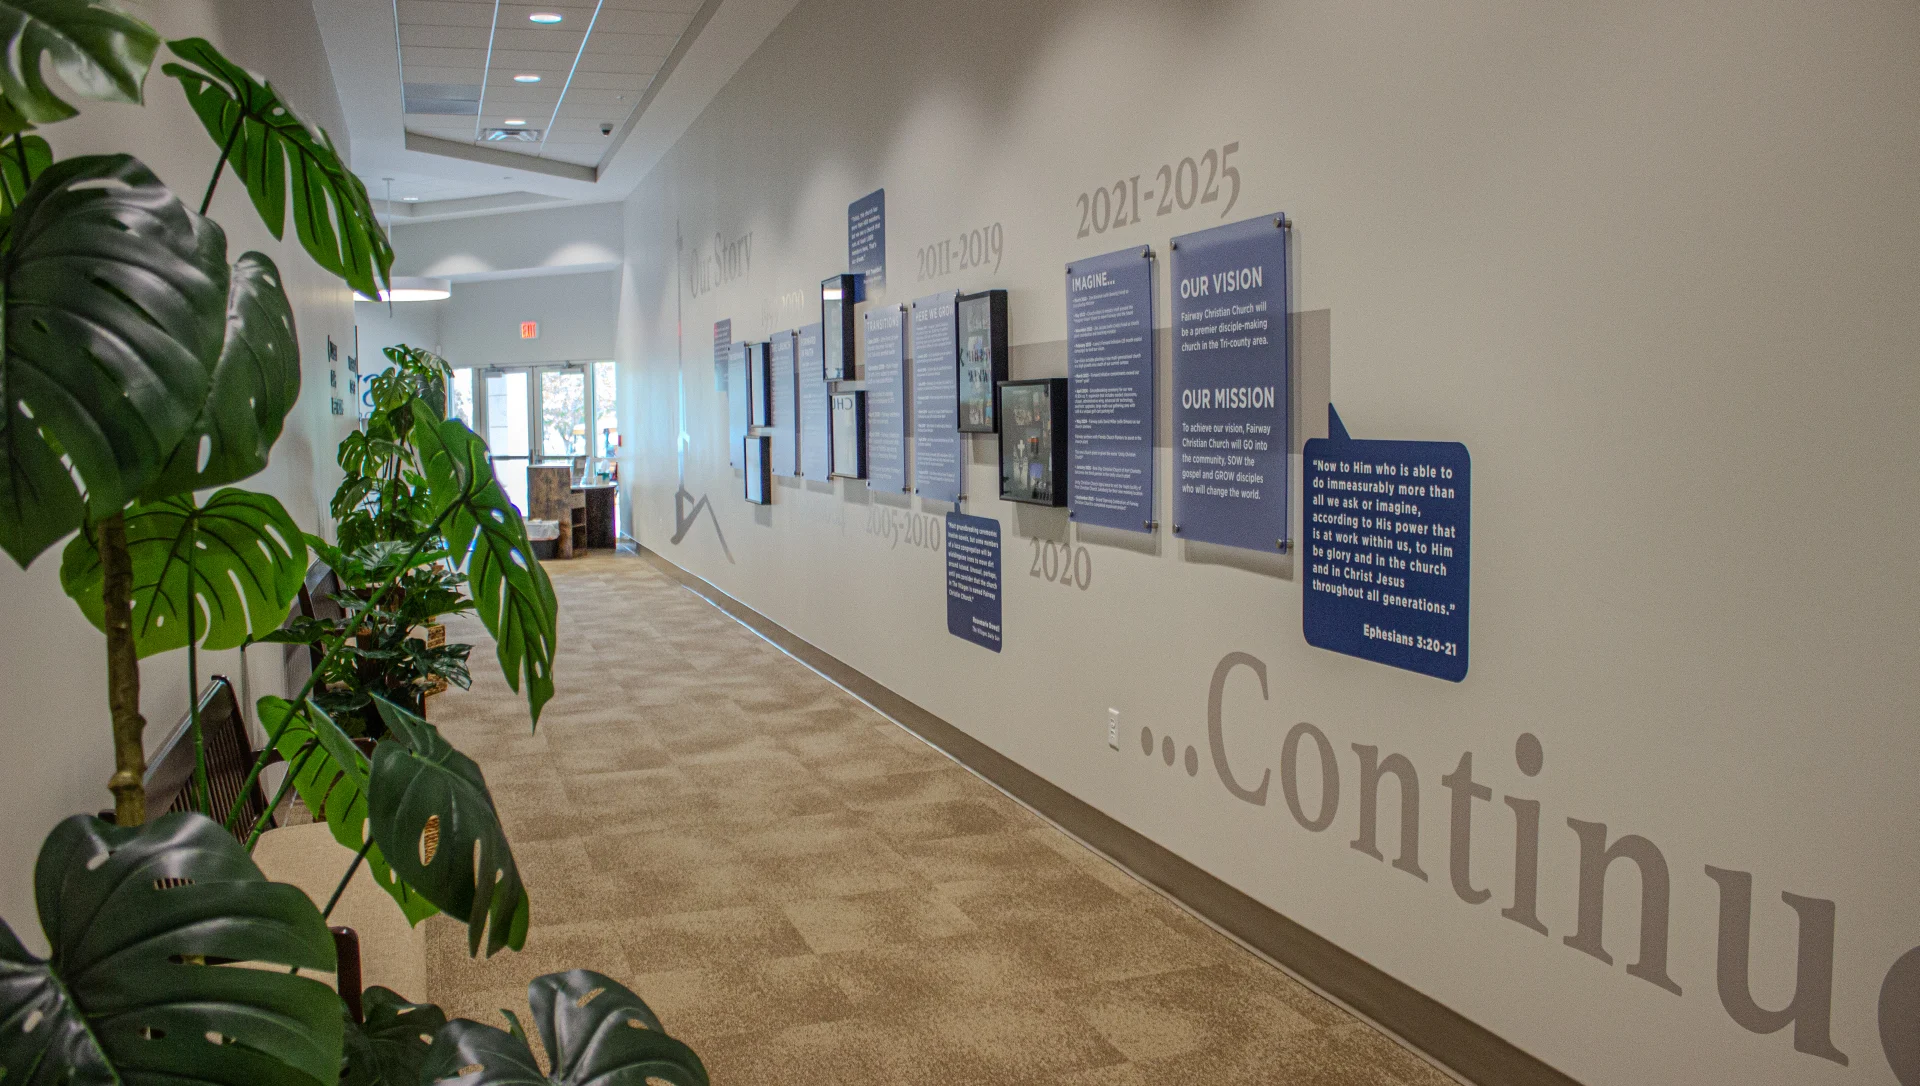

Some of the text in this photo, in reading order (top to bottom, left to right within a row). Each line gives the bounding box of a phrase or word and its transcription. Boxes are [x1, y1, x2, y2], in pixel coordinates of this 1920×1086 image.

[1075, 141, 1241, 239] 2021-2025
[916, 222, 1004, 283] 2011-2019
[691, 231, 754, 299] Our Story
[1072, 272, 1116, 293] IMAGINE...
[1181, 266, 1262, 298] OUR VISION
[1181, 301, 1266, 321] Fairway Christian Church will
[522, 322, 537, 338] EXIT
[1182, 328, 1188, 336] be
[1195, 326, 1217, 336] premier
[1219, 319, 1267, 333] disciple-making
[1182, 337, 1268, 351] church in the Tri-county area.
[1183, 387, 1274, 409] OUR MISSION
[1182, 423, 1189, 432] To
[1191, 423, 1212, 432] achieve
[1225, 423, 1244, 434] vision,
[1246, 423, 1271, 435] Fairway
[1183, 438, 1267, 450] Christian Church will GO into
[1182, 454, 1255, 466] the community, SOW the
[1313, 460, 1452, 479] “Now to Him who is able to
[1182, 470, 1263, 484] gospel and GROW disciples
[1313, 477, 1454, 498] do immeasurably more than
[1183, 484, 1260, 499] who will change the world.
[1313, 494, 1421, 517] all we ask or imagine,
[866, 506, 941, 552] 2005-2010
[1313, 513, 1455, 538] according to His power that
[1313, 528, 1452, 557] is at work within us, to Him
[1029, 536, 1093, 592] 2020
[1313, 545, 1446, 576] be glory and in the church
[1313, 564, 1404, 588] and in Christ Jesus
[1313, 579, 1455, 615] throughout all generations.”
[1364, 624, 1456, 656] Ephesians 3:20-21
[1140, 651, 1920, 1086] ...Continu
